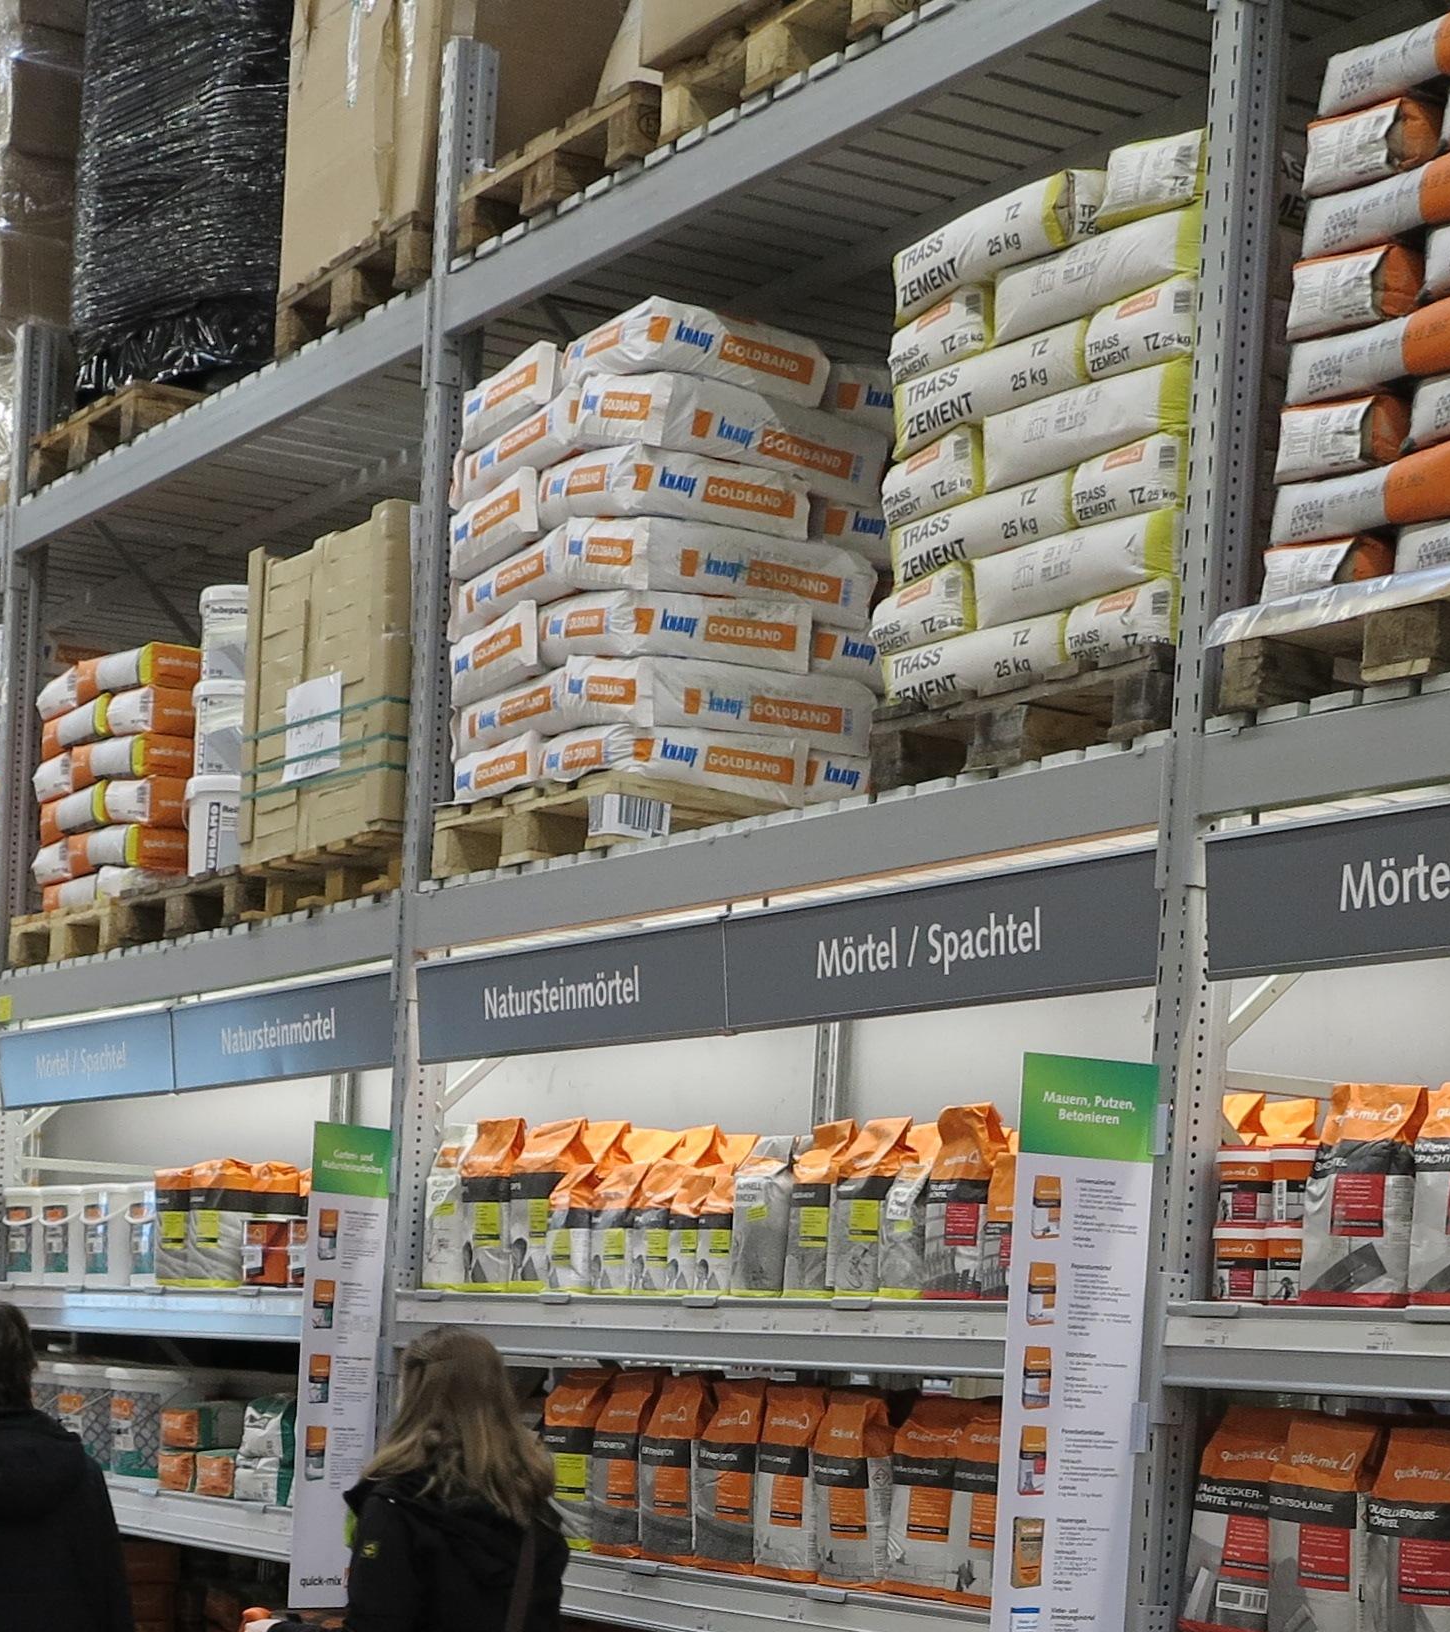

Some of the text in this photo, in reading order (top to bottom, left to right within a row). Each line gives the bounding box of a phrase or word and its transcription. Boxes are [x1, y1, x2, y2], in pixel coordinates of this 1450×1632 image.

[1004, 203, 1022, 223] TZ
[900, 233, 1022, 274] TRASS 25 kg
[900, 257, 959, 309] ZEMENT
[675, 323, 801, 377] KNAUF GOLDBAND
[1030, 338, 1049, 358] TZ
[1088, 334, 1120, 356] TRASS
[1143, 332, 1160, 352] TZ
[1090, 348, 1130, 373] ZEMENT
[907, 367, 1048, 406] TRASS 25 kg
[907, 392, 972, 440] ZEMENT
[658, 467, 784, 510] KNAUF GOLDBAND
[659, 607, 784, 645] KNAUF GOLDBAND
[659, 739, 782, 777] KNAUF GOLDBAND
[816, 906, 1042, 980] Mörtel / Spachtel
[483, 966, 641, 1021] Natursteinmörtel
[220, 1007, 337, 1057] Natursteinmörtel
[35, 1053, 70, 1080] Mörtel
[82, 1042, 127, 1079] Spachtel
[1042, 1090, 1136, 1111] Mauern, Putzen,
[1058, 1109, 1120, 1126] Betonieren
[299, 1575, 342, 1588] quick-mix
